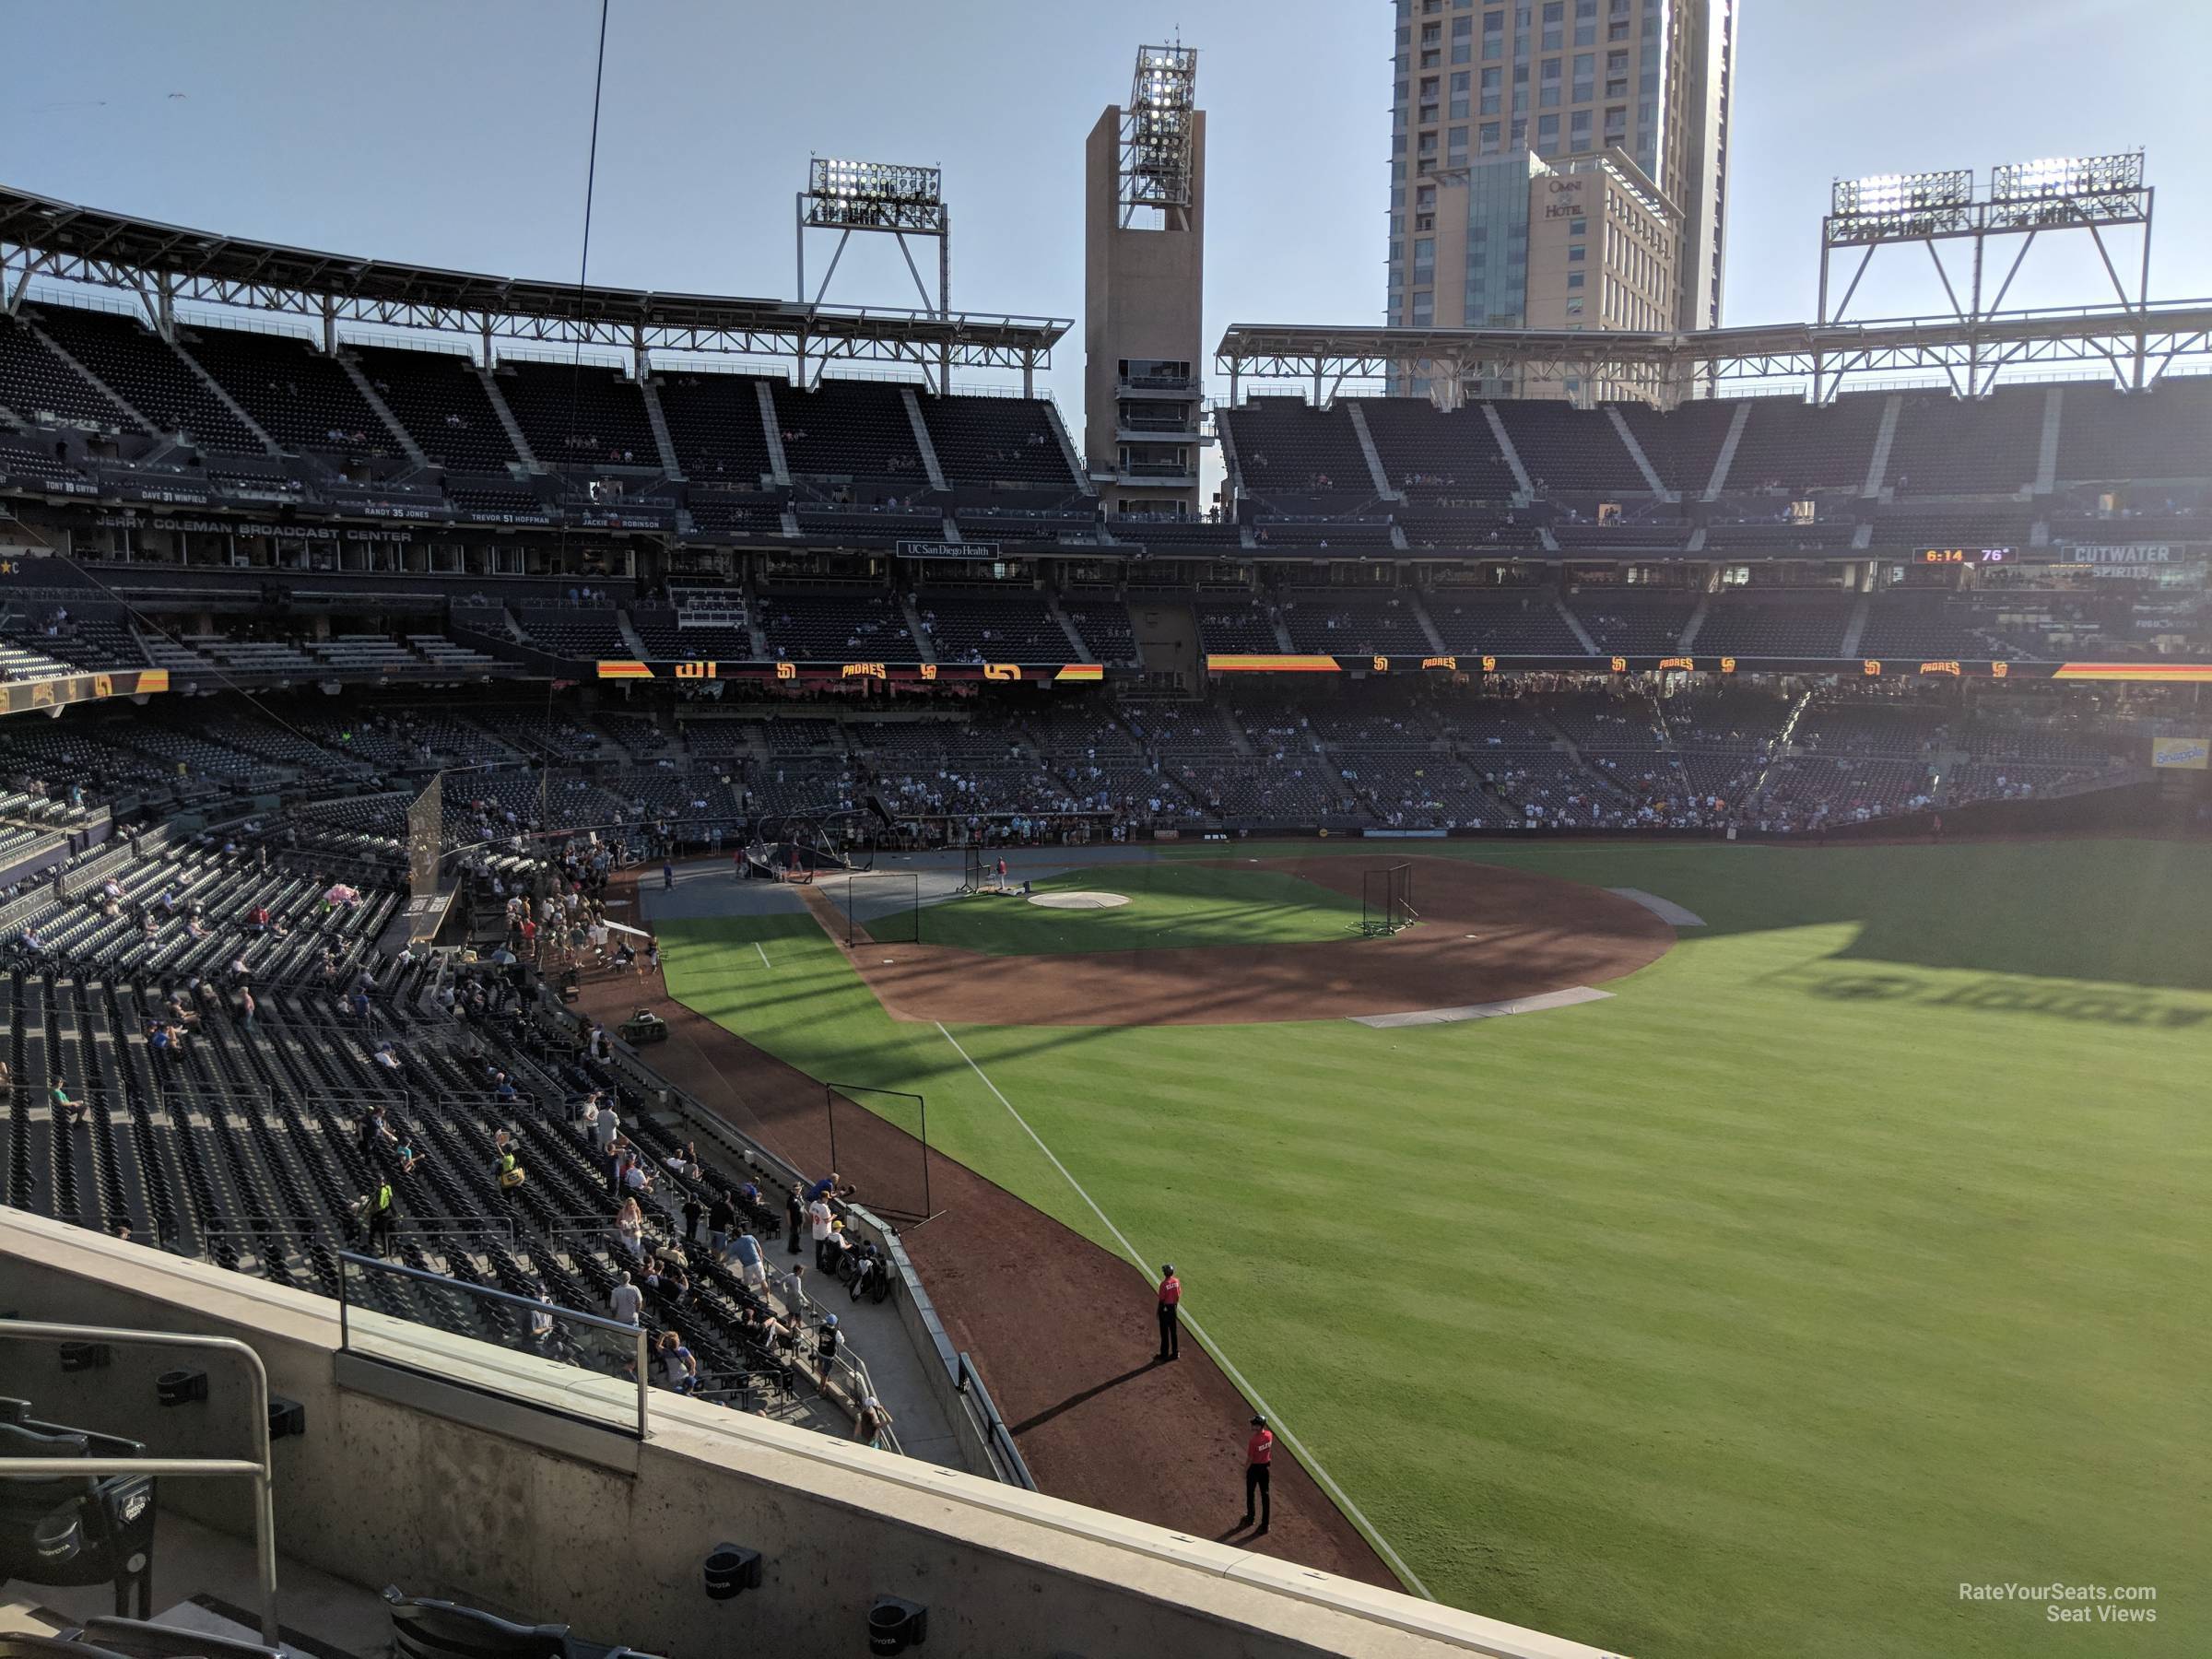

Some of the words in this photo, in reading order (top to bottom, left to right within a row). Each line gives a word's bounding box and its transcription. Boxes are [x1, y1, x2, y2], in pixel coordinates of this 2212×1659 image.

[1549, 180, 1582, 193] OMNI
[1546, 204, 1583, 218] HOTEL
[45, 480, 64, 491] TONY
[65, 482, 75, 493] 19
[142, 490, 161, 500] DAVE
[163, 492, 173, 502] 31
[174, 493, 207, 503] WINFIELD
[364, 507, 390, 517] RANDY
[393, 508, 404, 518] 35
[405, 510, 429, 519] JONES
[471, 513, 500, 523] TREVOR
[502, 514, 513, 524] 51
[515, 515, 550, 524] HOFFMAN
[96, 515, 147, 529] JERRY
[153, 518, 232, 534] COLEMAN
[239, 523, 339, 538] BROADCAST
[347, 529, 412, 543] CENTER
[582, 518, 608, 527] JACKIE
[622, 520, 660, 529] ROBINSON
[908, 544, 923, 554] UC
[923, 545, 938, 554] San
[939, 545, 962, 557] Diego
[962, 545, 989, 556] Health
[1926, 549, 1963, 561] 6:14
[2075, 547, 2169, 561] CUTWATER
[2093, 566, 2149, 578] SPIRITS
[1422, 656, 1456, 671] PADRES
[1659, 657, 1693, 671] PADRES
[1920, 661, 1961, 677] PADRES
[841, 663, 887, 679] PADRES
